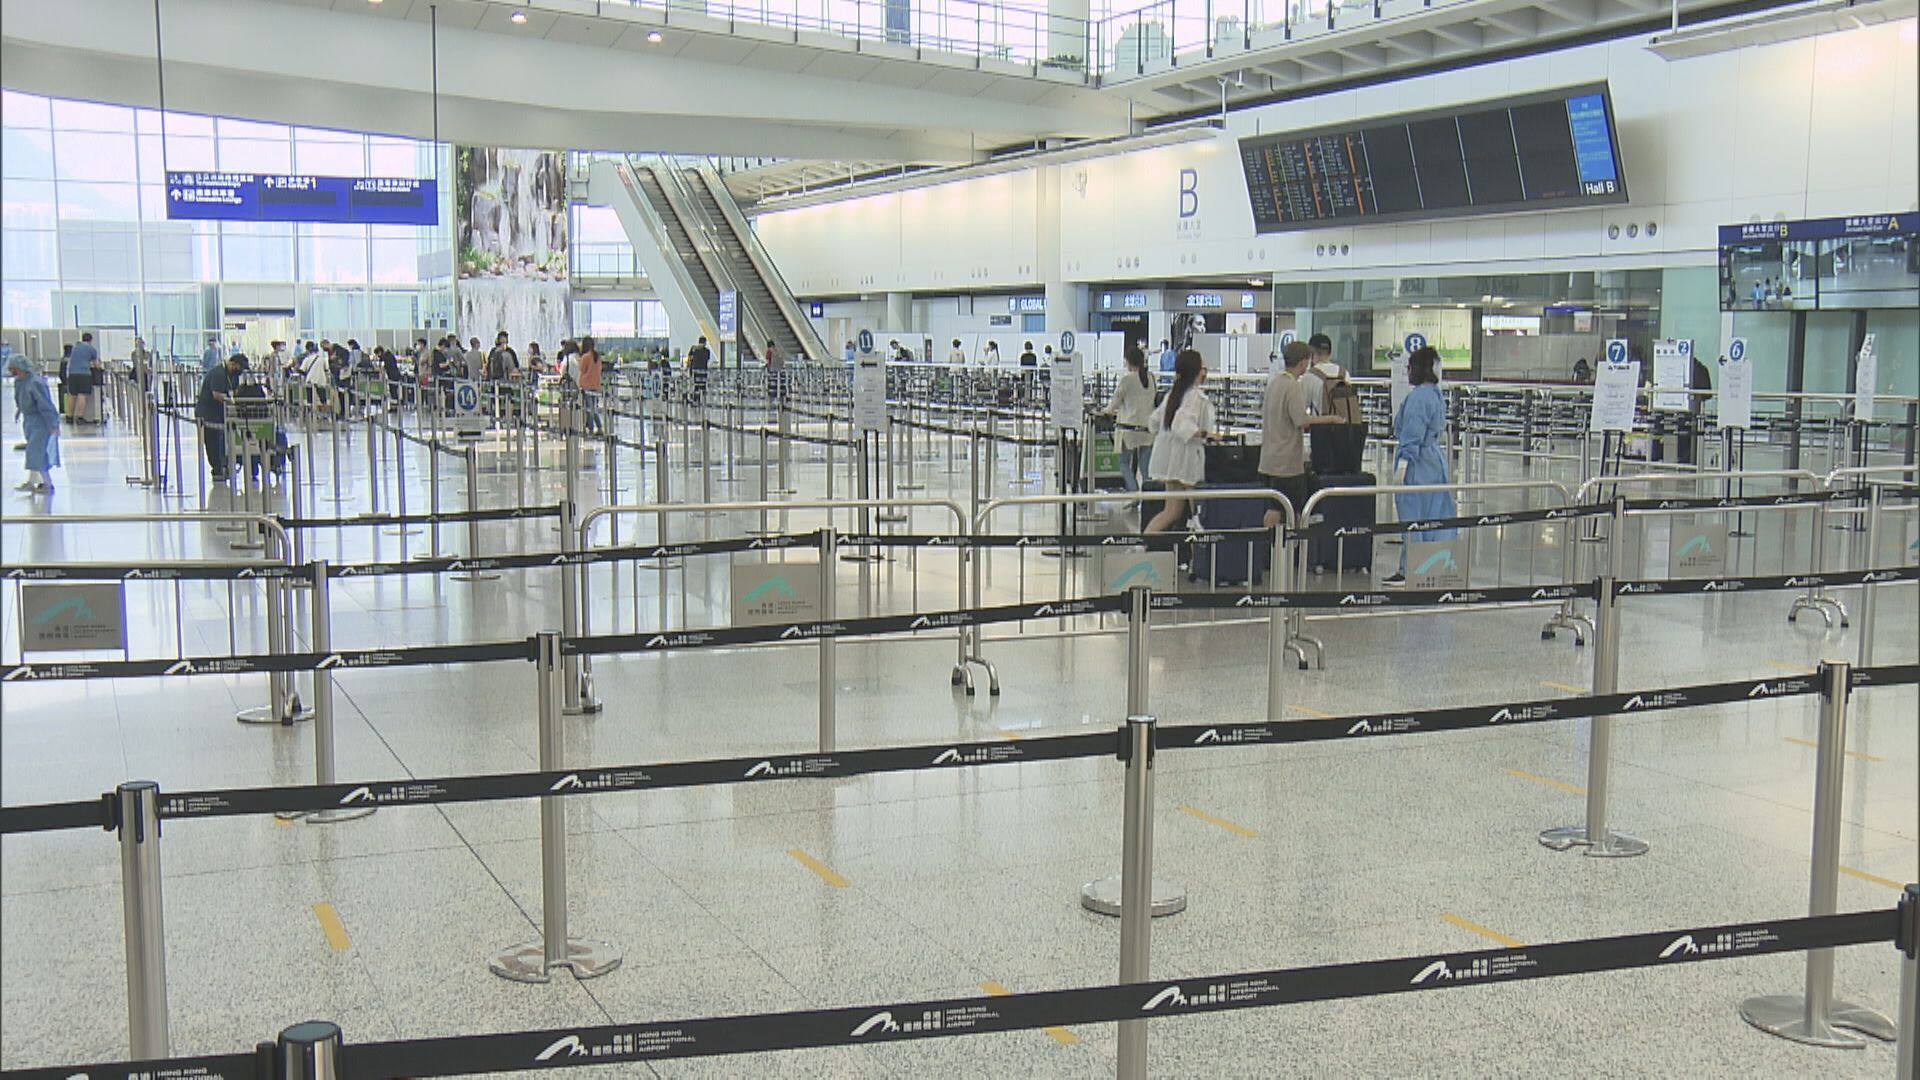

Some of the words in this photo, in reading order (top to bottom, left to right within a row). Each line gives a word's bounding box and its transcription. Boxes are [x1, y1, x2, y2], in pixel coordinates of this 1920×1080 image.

[1180, 168, 1198, 218] B
[1585, 182, 1604, 195] Hall
[1606, 181, 1614, 193] B
[1780, 224, 1788, 236] B
[1888, 216, 1899, 230] A
[1020, 298, 1044, 310] GLOBAL
[860, 330, 872, 351] 11
[1063, 333, 1072, 353] 10
[1409, 335, 1422, 350] 8
[1612, 344, 1622, 360] 7
[1733, 342, 1740, 358] 6
[460, 389, 475, 406] 14
